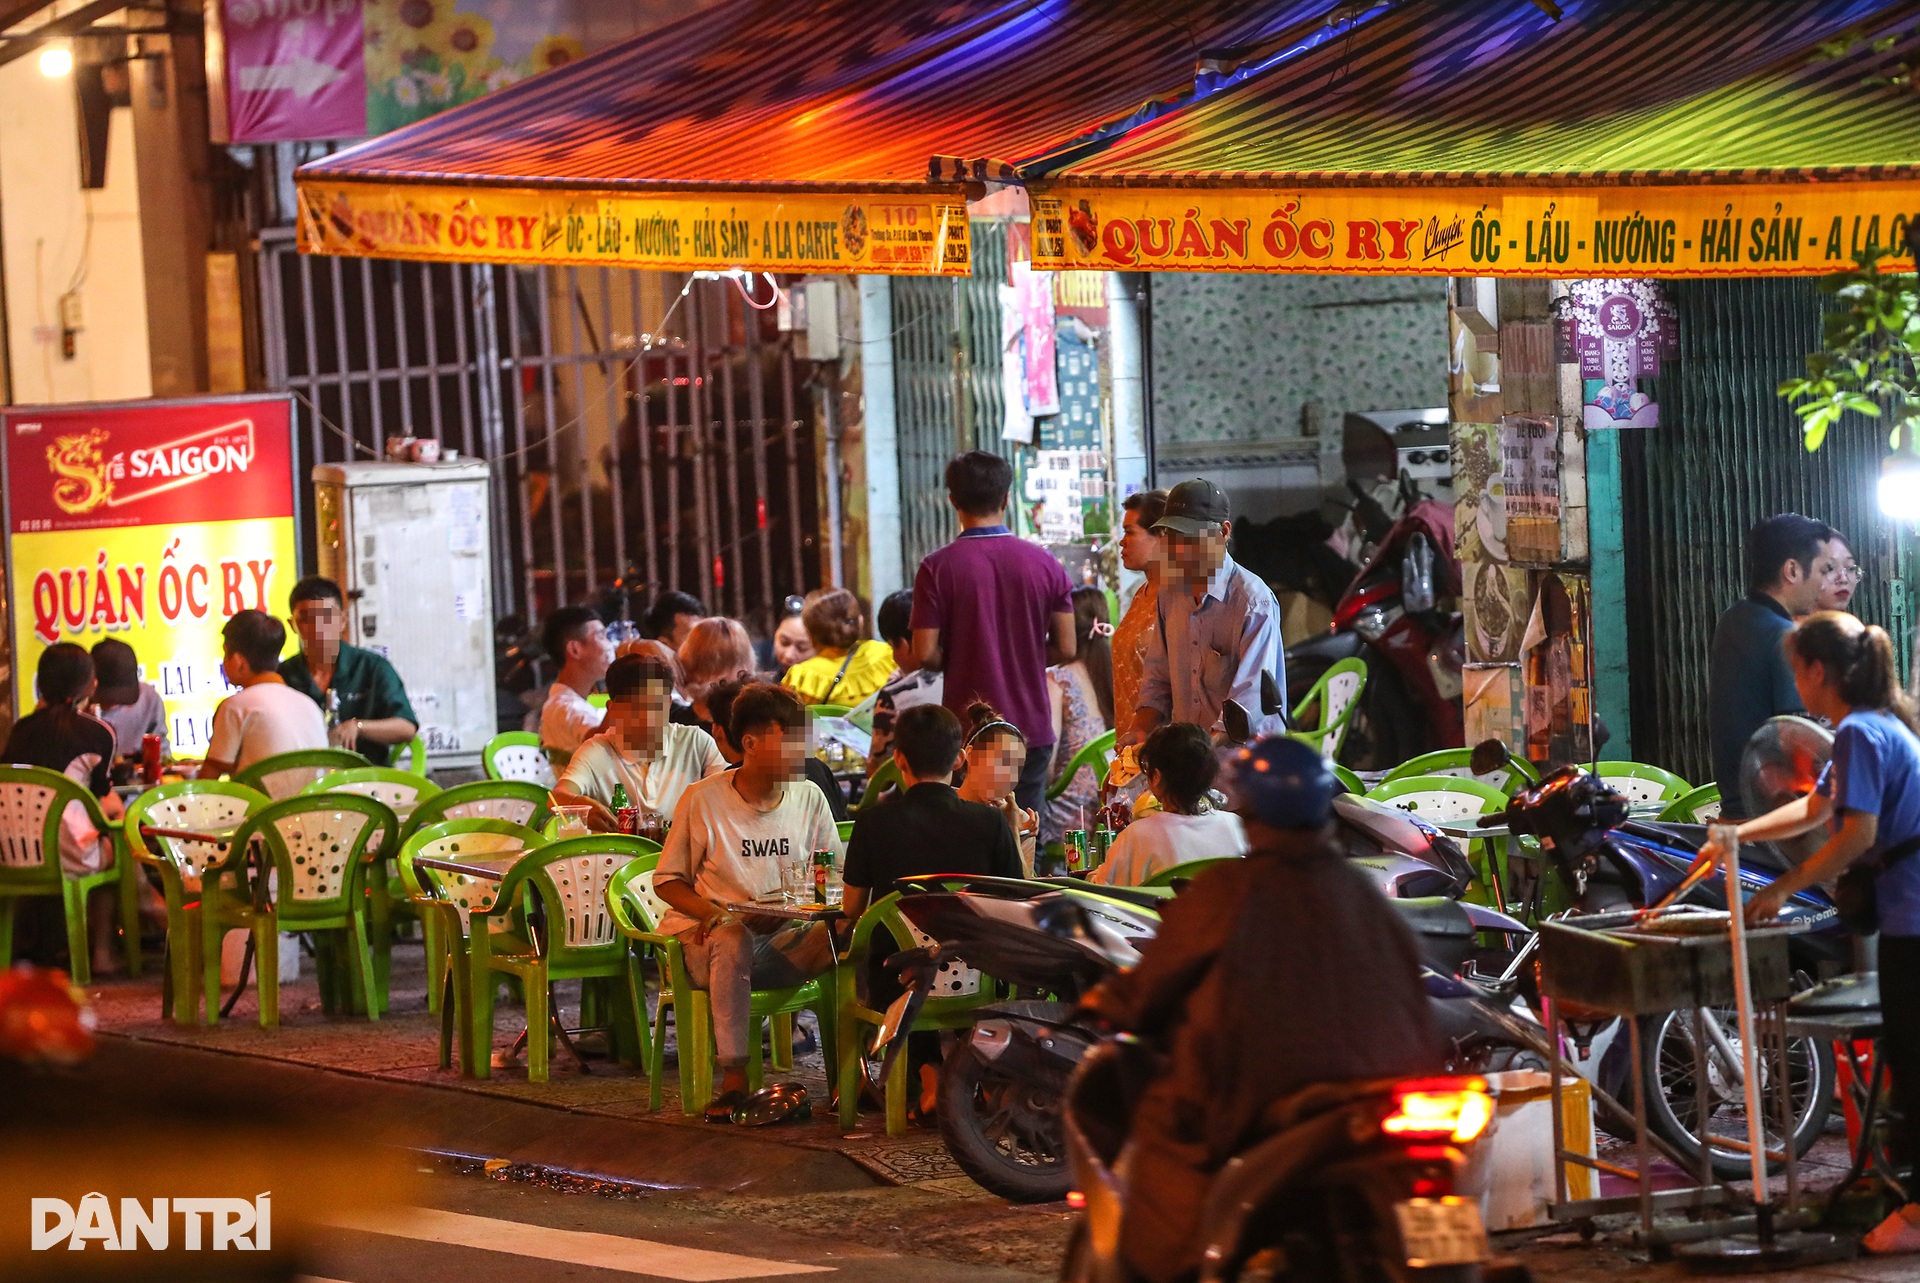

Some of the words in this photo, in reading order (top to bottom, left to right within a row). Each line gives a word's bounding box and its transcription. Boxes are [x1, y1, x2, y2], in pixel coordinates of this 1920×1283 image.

[449, 200, 488, 248] ỐC
[496, 215, 539, 250] RY
[566, 202, 584, 253] ỐC
[635, 210, 681, 257] NƯỚNG
[694, 206, 717, 258] HẢI
[720, 207, 749, 259] SẢN
[763, 221, 772, 259] A
[775, 221, 793, 260] LA
[796, 221, 840, 261] CARTE
[882, 206, 918, 227] 110
[1102, 207, 1249, 266] QUÁN
[1263, 202, 1333, 260] ỐC
[1346, 220, 1422, 261] RY
[1470, 204, 1500, 263] ỐC
[1525, 202, 1569, 263] LẨU
[1593, 211, 1676, 263] NƯỚNG
[1700, 203, 1742, 262] HẢI
[1749, 202, 1802, 262] SẢN
[1825, 216, 1842, 260] A
[130, 444, 248, 478] SAIGON
[33, 550, 145, 644] QUÁN
[159, 538, 209, 621] ỐC
[220, 558, 274, 617] RY
[741, 838, 789, 857] SWAG
